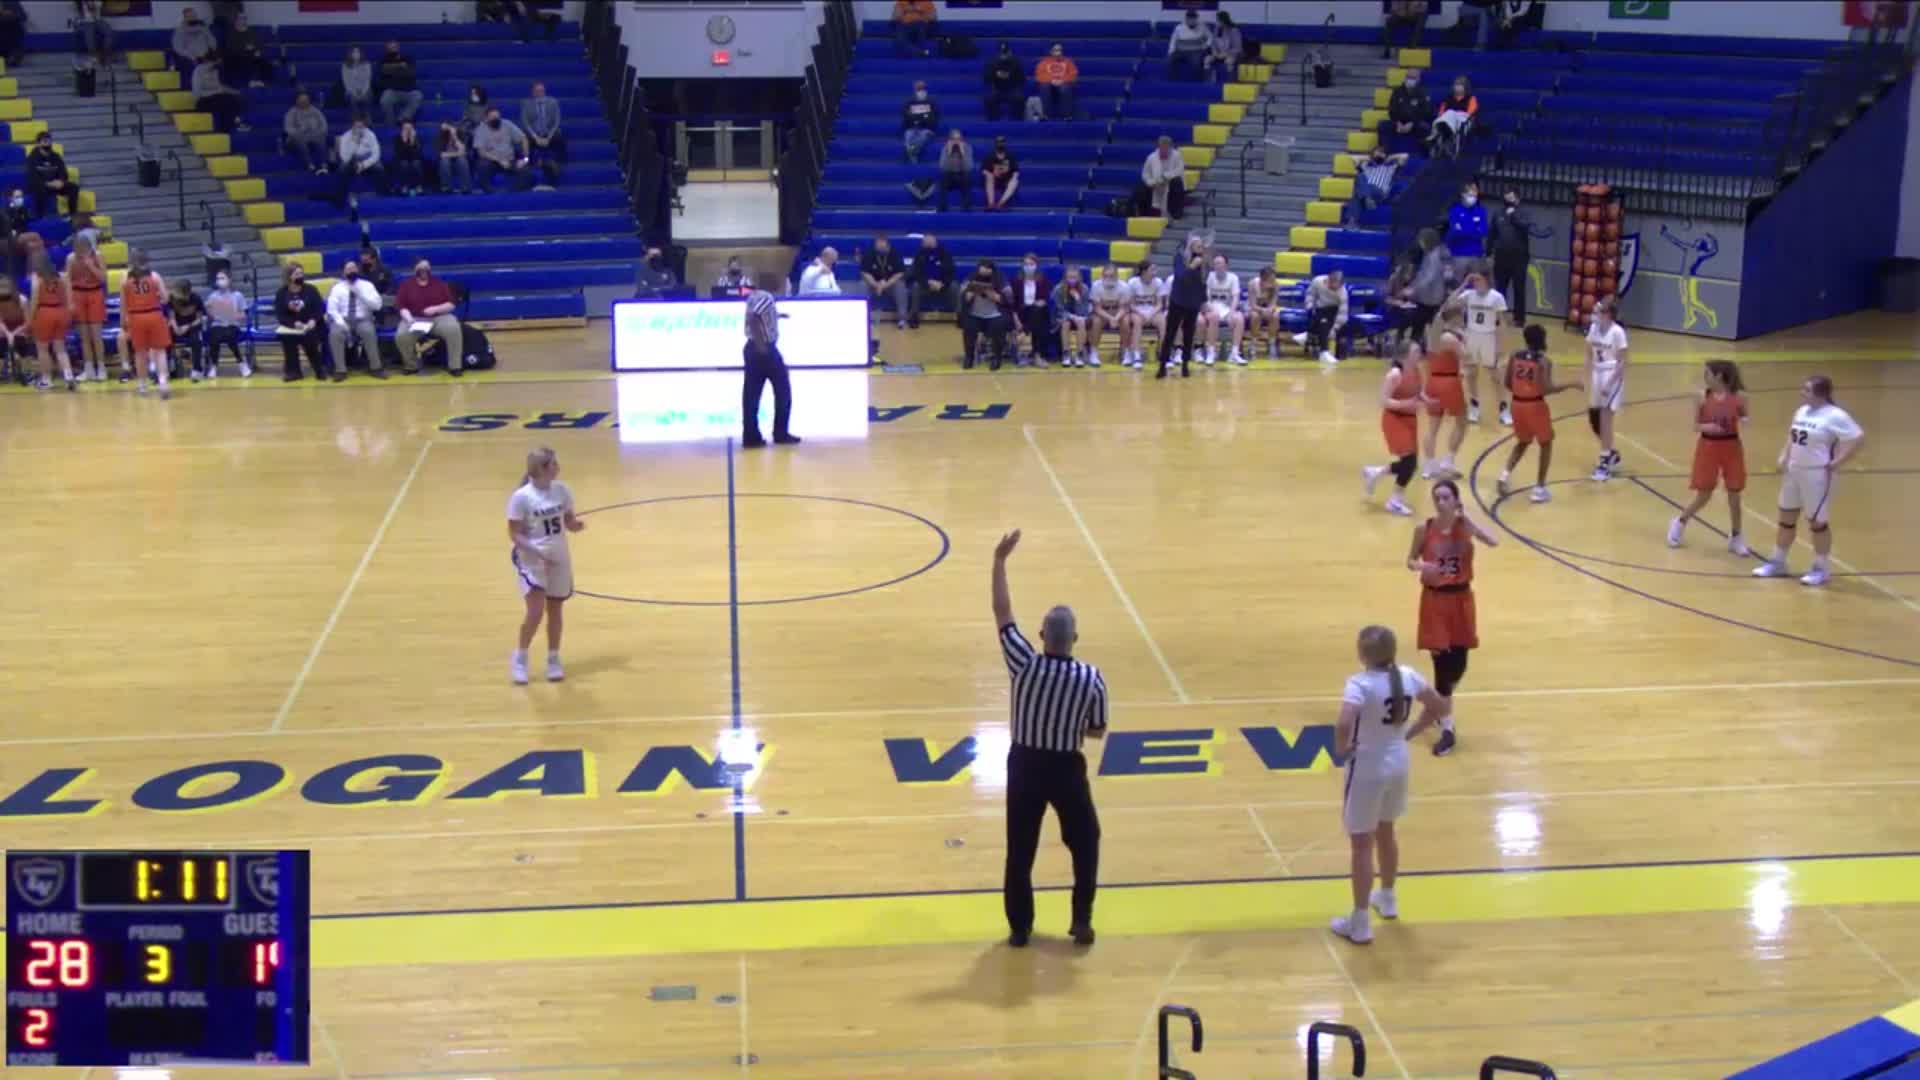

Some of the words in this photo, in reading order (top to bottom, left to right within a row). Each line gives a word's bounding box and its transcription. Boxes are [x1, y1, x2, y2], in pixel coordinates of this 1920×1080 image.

[1515, 367, 1535, 382] 24
[543, 516, 562, 536] 15
[0, 745, 770, 816] LOGAN
[883, 725, 1346, 784] VEW
